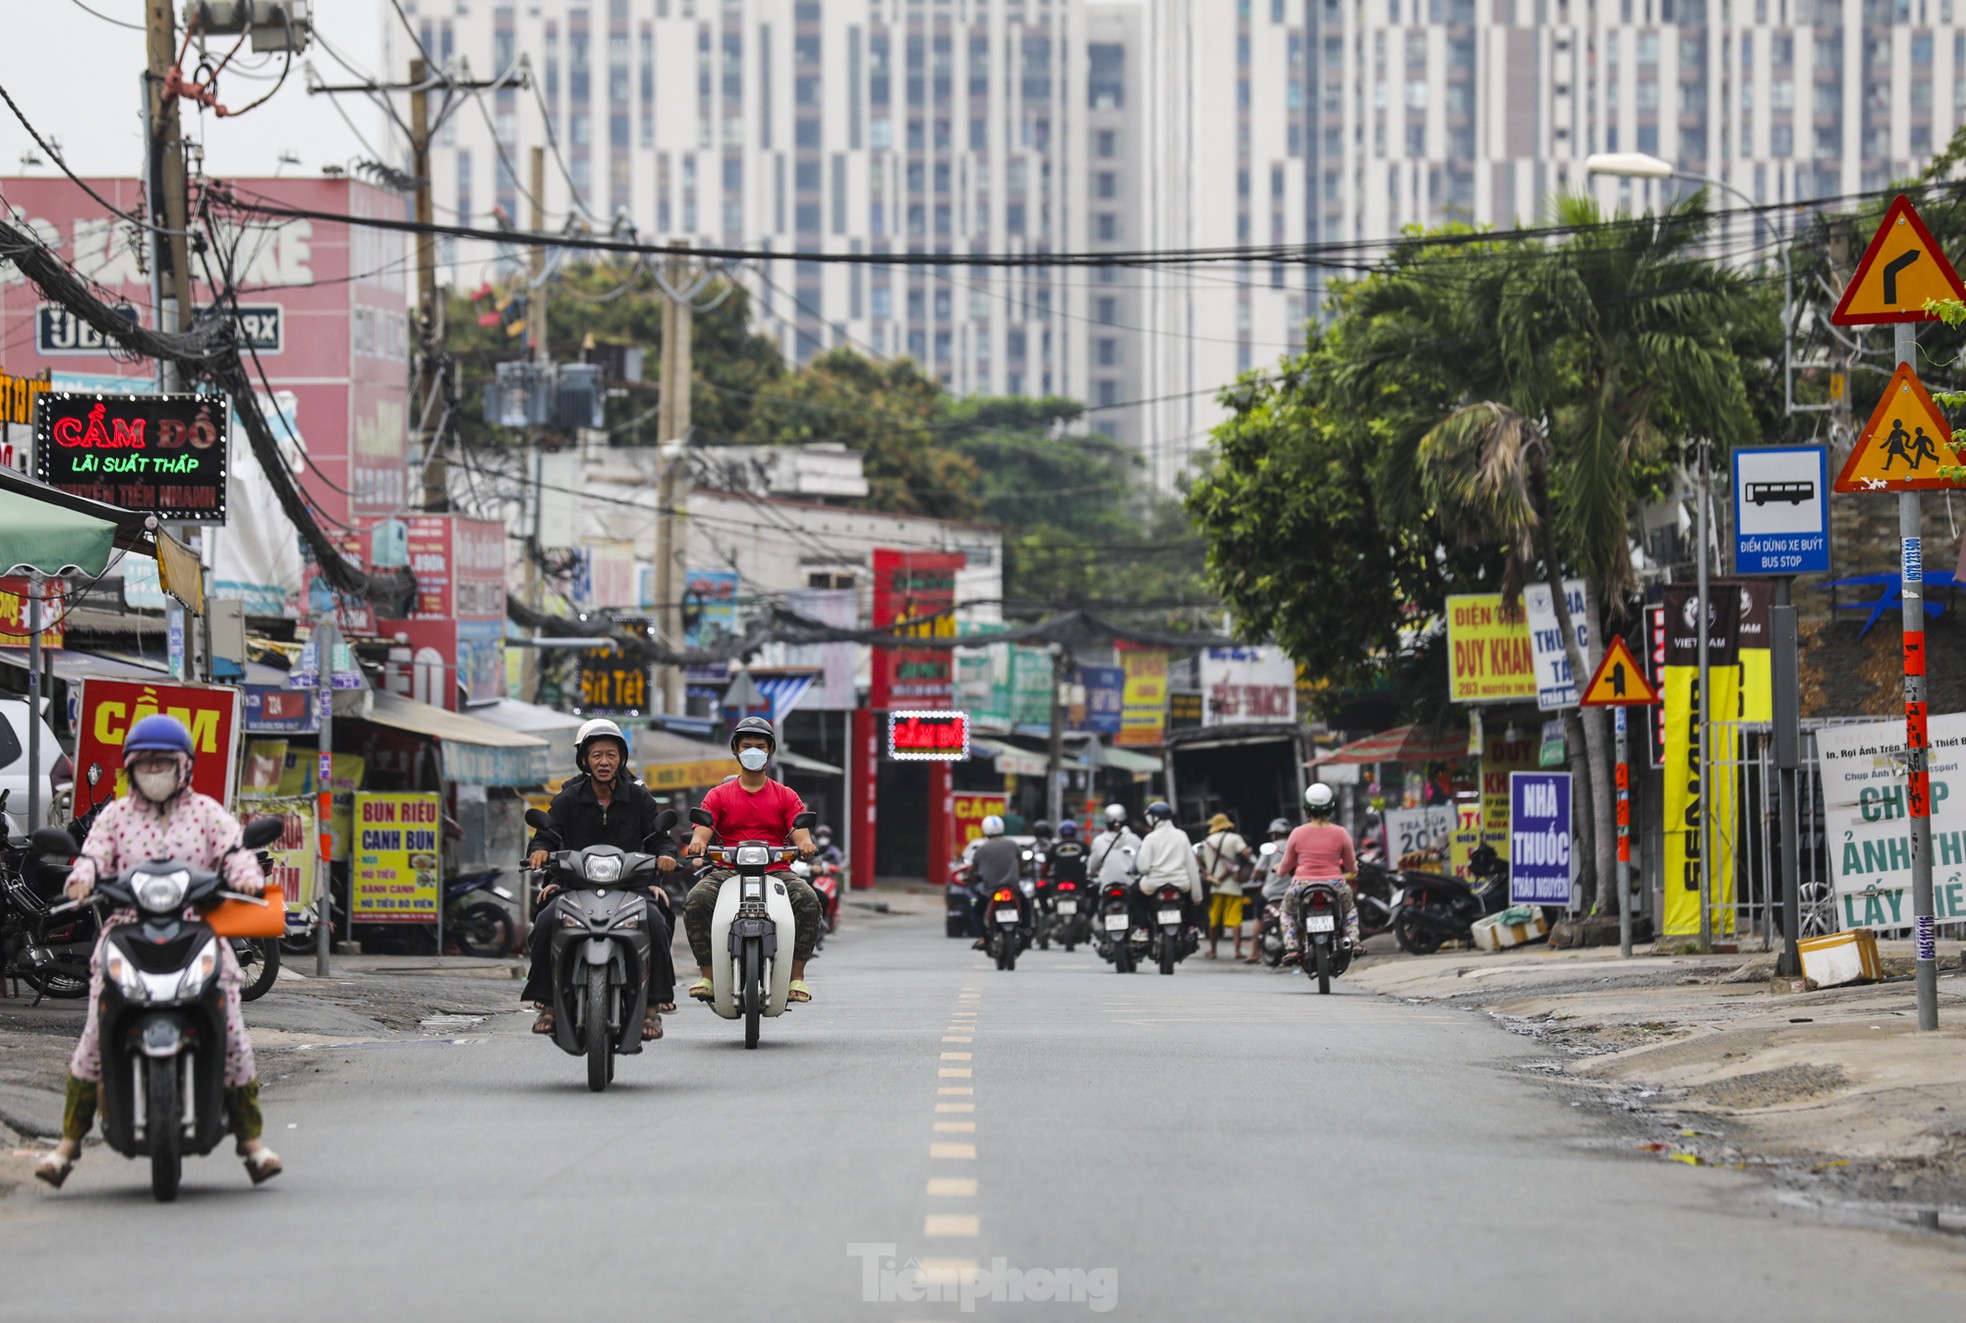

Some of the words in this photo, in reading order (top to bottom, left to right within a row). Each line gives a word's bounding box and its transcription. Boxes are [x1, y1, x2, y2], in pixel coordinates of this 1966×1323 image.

[53, 403, 147, 448] CẦM
[157, 405, 217, 449] ĐỒ
[72, 454, 99, 472] LÃI
[102, 453, 149, 472] SUẤT
[153, 454, 199, 473] THẤP
[159, 485, 216, 508] NHANH
[1762, 556, 1779, 568] BUS
[1780, 556, 1802, 568] STOP
[1789, 540, 1800, 551] XE
[1801, 536, 1823, 550] BUÝT
[1455, 638, 1485, 677] DUY
[1674, 637, 1726, 648] VIETAM
[1523, 779, 1558, 818] NHÀ
[1859, 780, 1950, 822] CHP
[361, 829, 401, 851] CANH
[1513, 821, 1569, 866] THUỐC
[1842, 830, 1911, 876] ẢNH
[1843, 877, 1904, 928] LẤY
